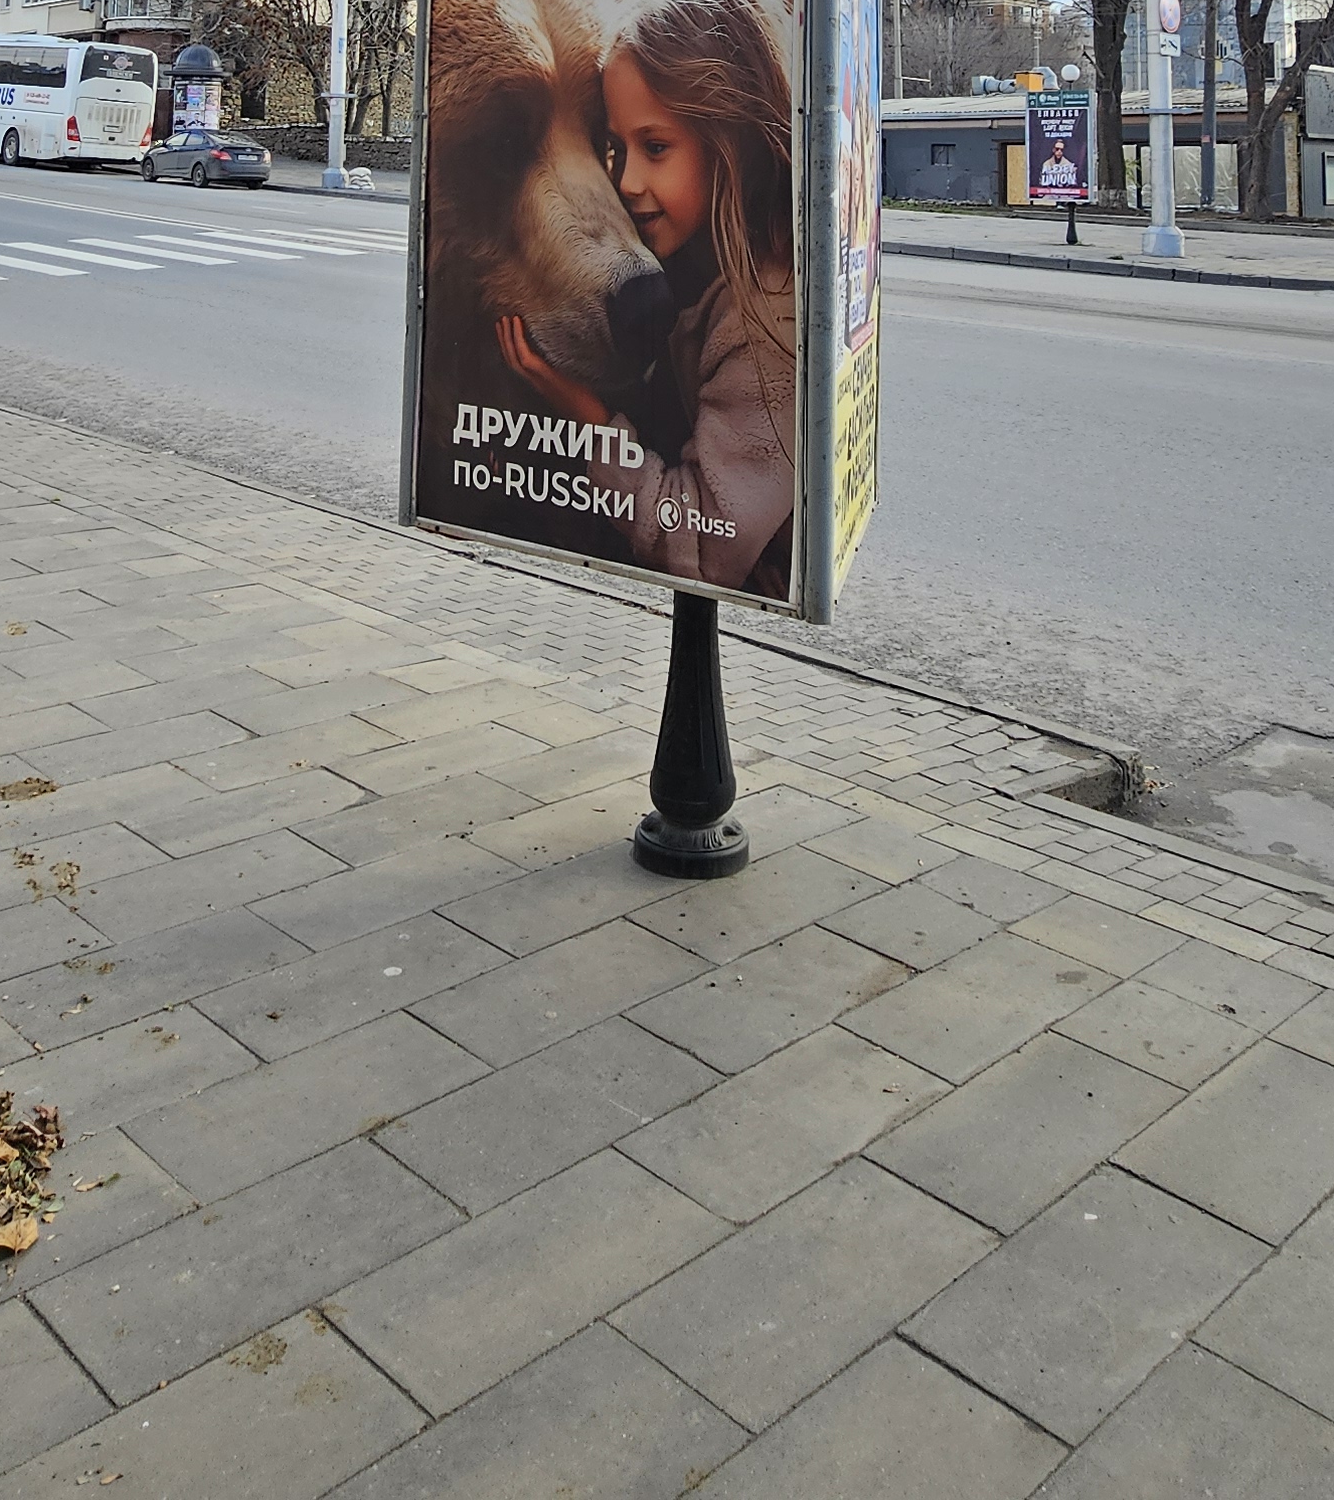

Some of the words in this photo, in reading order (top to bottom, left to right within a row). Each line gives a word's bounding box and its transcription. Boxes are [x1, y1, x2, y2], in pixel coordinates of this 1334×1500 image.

[1041, 172, 1077, 187] UNION
[453, 403, 645, 469] ДРУЖИТЬ
[687, 508, 737, 539] Russ
